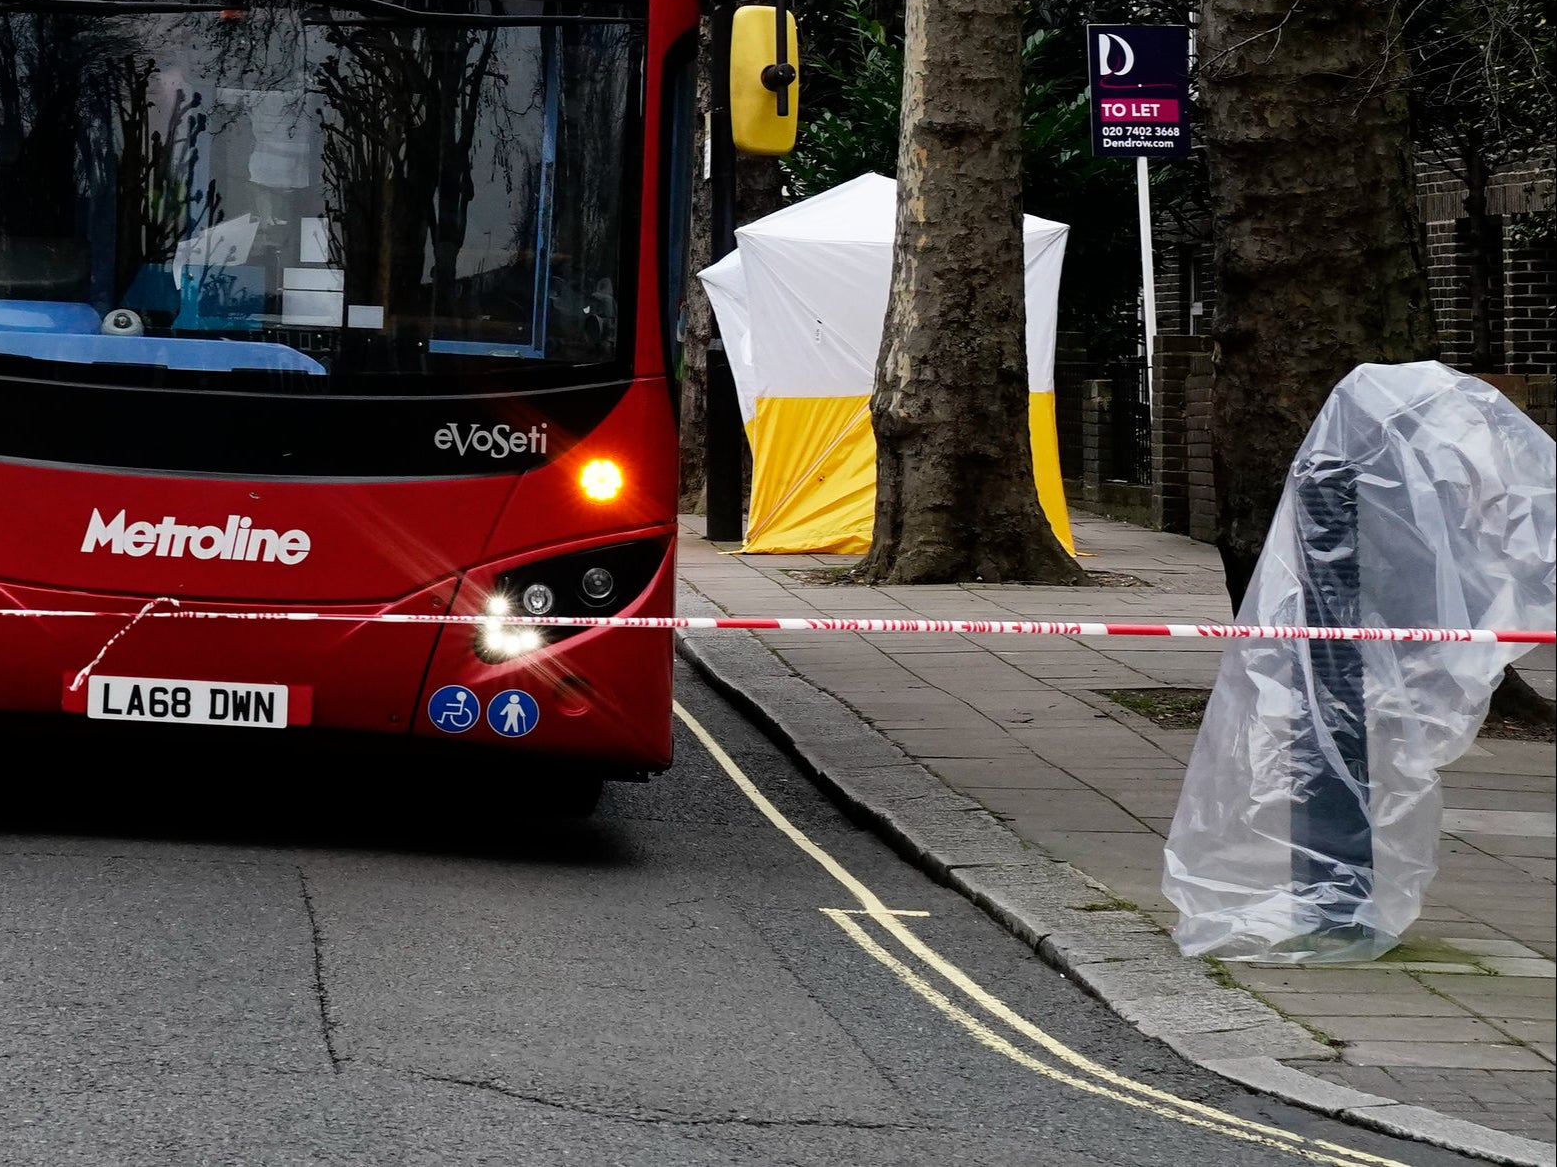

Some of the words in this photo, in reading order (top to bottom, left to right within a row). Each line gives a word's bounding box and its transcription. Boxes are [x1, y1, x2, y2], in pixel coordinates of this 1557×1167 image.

[1102, 103, 1126, 117] TO
[1131, 103, 1160, 117] LET
[1102, 126, 1122, 136] 020
[1125, 126, 1152, 136] 7402
[1155, 127, 1180, 136] 3668
[1103, 137, 1174, 148] Dendrow.com
[434, 422, 547, 459] eVoSeti
[80, 507, 311, 565] Metroline
[103, 683, 191, 718] LA68
[209, 689, 274, 723] DWN
